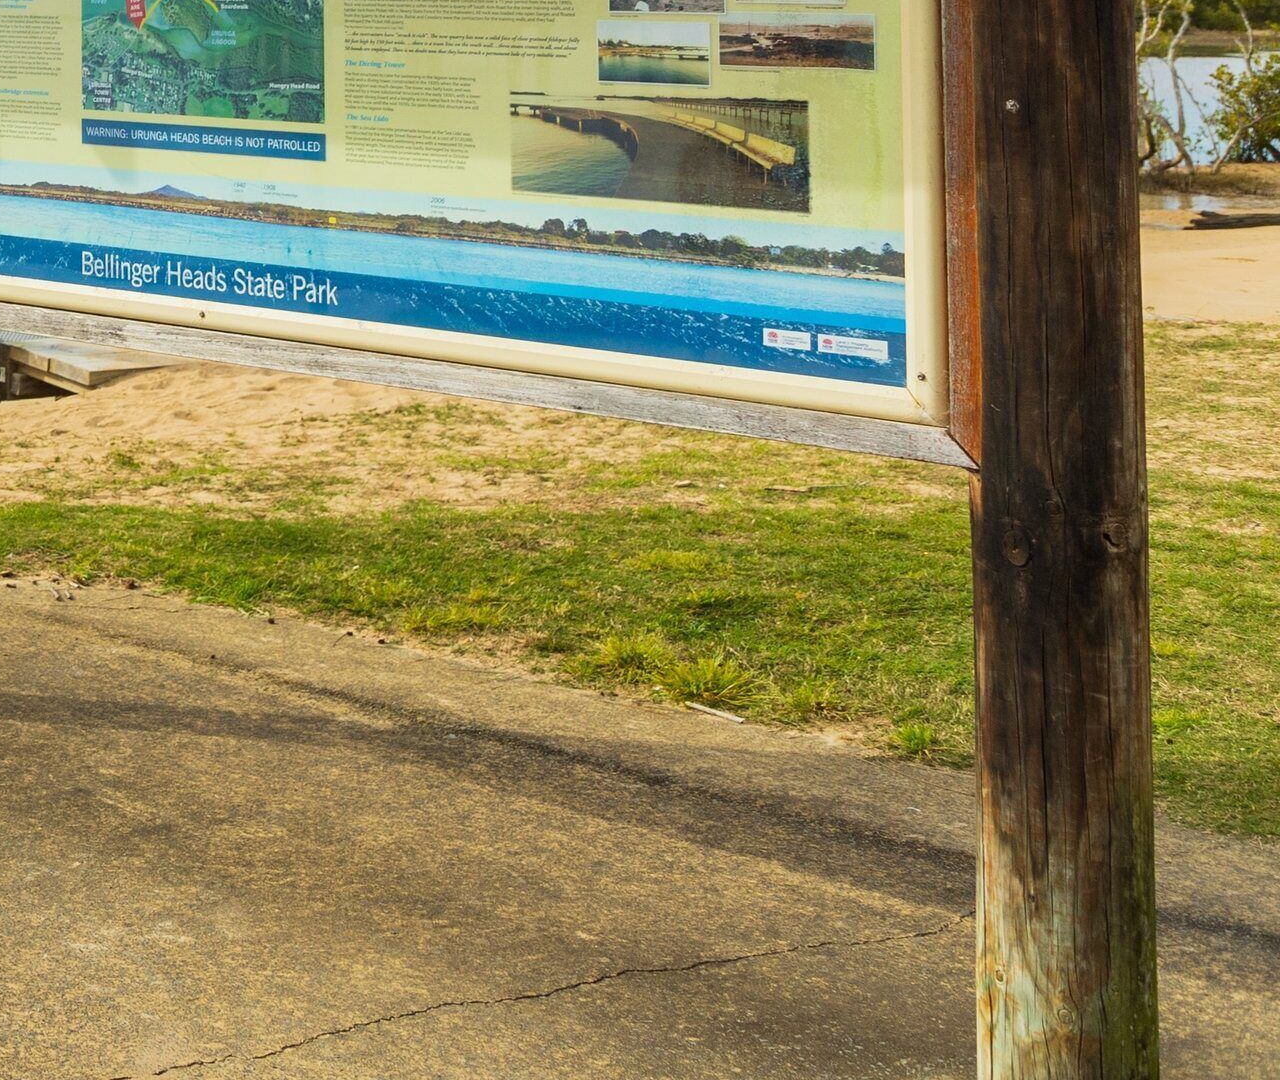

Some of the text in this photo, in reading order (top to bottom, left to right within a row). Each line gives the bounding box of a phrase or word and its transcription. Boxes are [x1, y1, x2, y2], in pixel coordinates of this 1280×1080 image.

[86, 127, 320, 152] WARNING: URUNGA HEADS BEACH IS NOT PATROLLED
[82, 252, 338, 305] Bellinger Heads State Park
